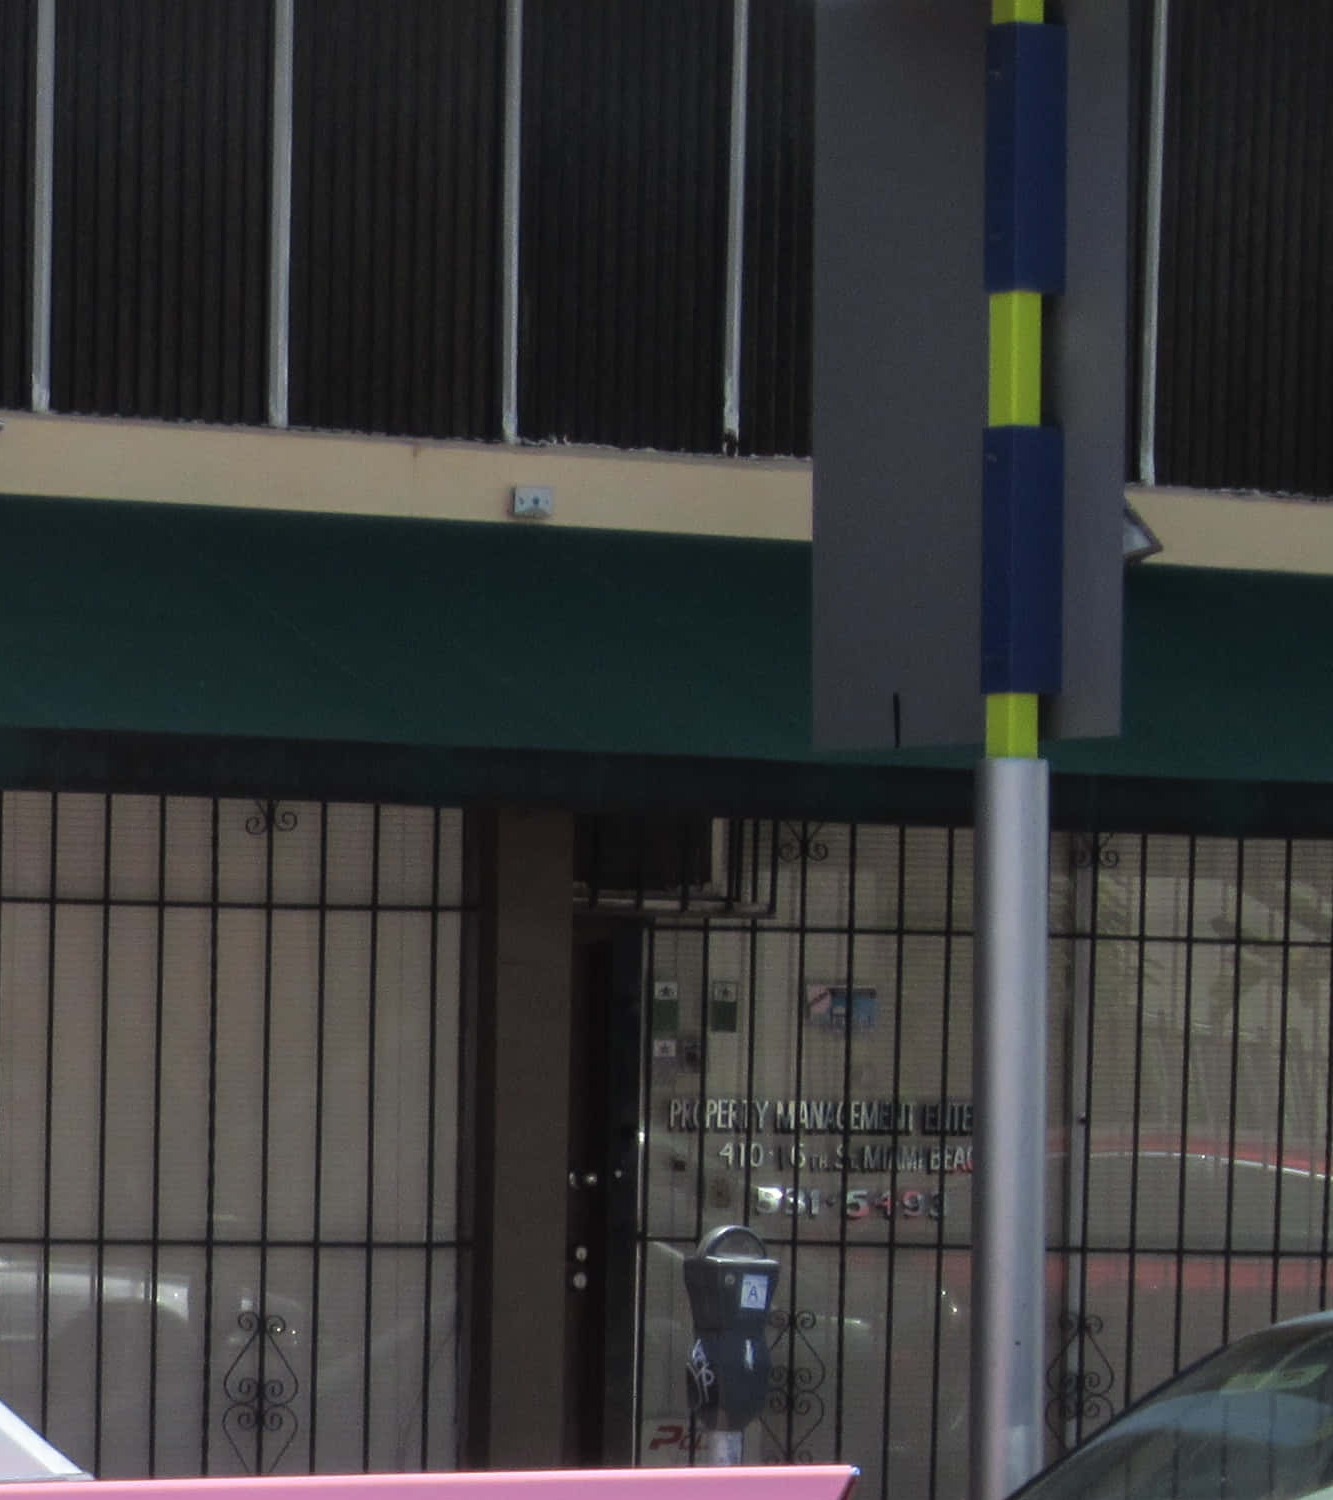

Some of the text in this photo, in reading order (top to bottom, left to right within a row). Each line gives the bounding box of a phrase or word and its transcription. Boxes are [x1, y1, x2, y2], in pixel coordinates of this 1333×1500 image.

[669, 1099, 769, 1129] PROPERTY
[930, 1145, 973, 1171] BEAC
[748, 1285, 759, 1300] A
